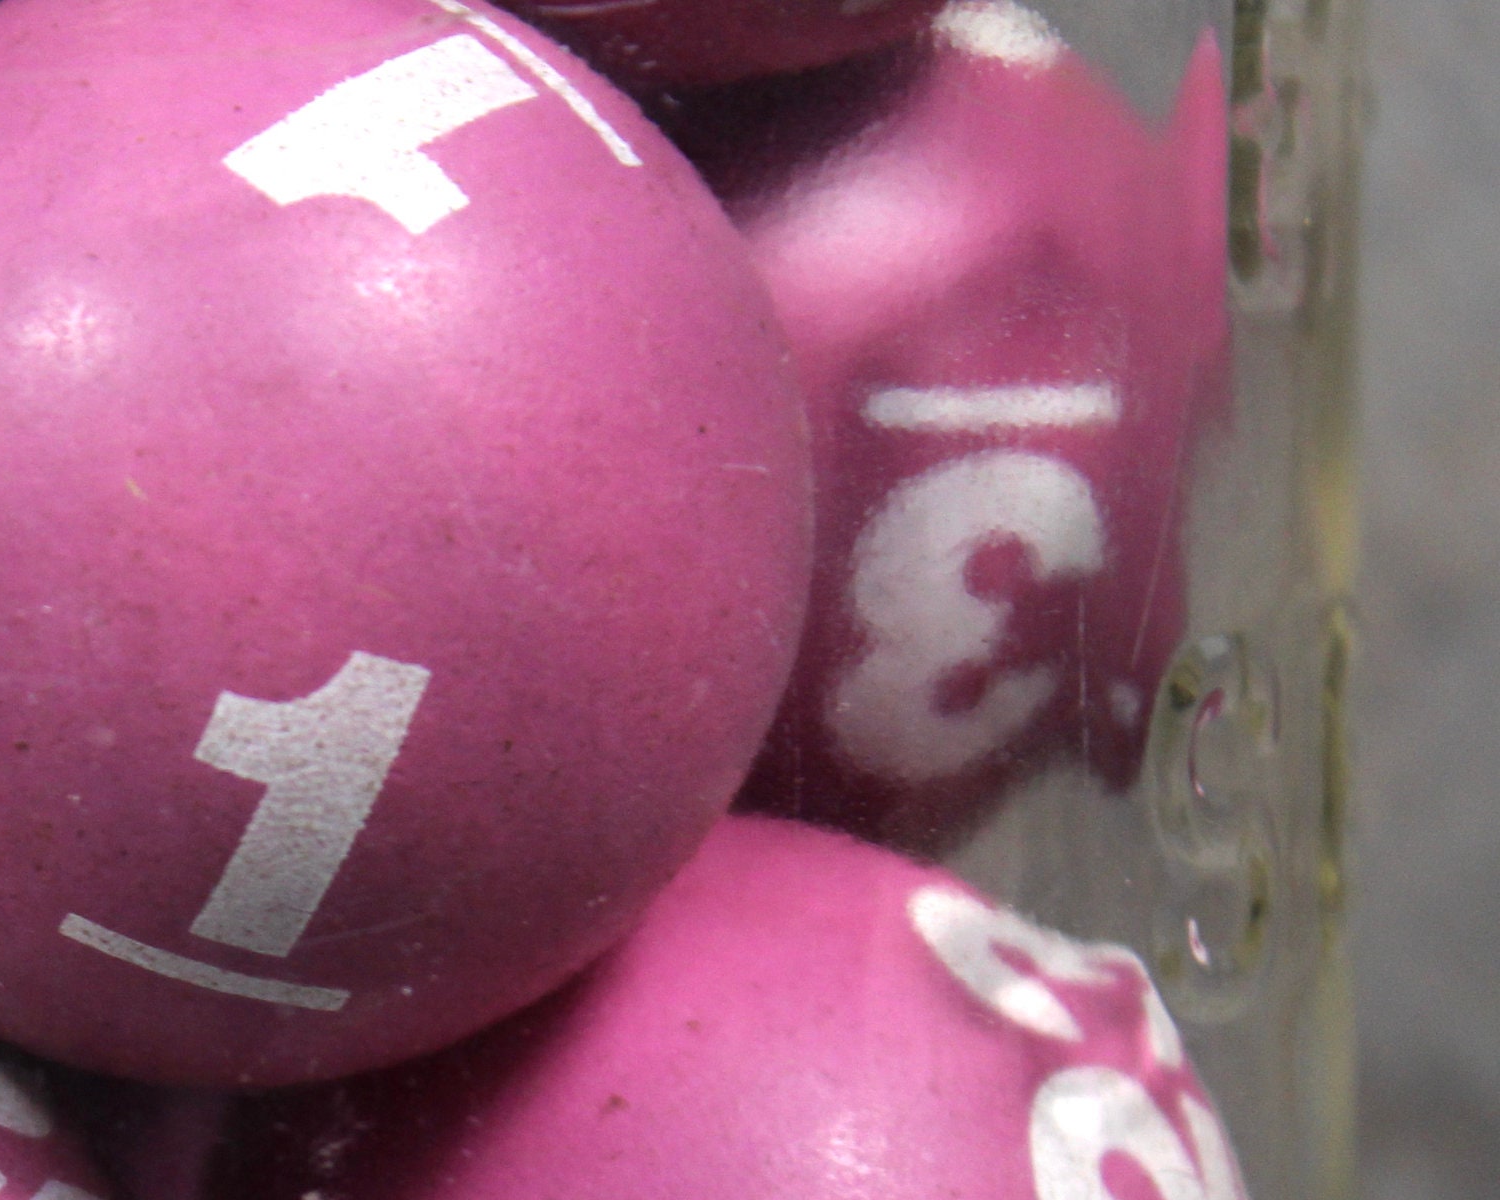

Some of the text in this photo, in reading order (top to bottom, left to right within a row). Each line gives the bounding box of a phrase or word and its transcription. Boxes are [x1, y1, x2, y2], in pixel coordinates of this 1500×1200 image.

[222, 33, 538, 235] 1
[823, 448, 1106, 783] 3
[192, 650, 432, 958] 1
